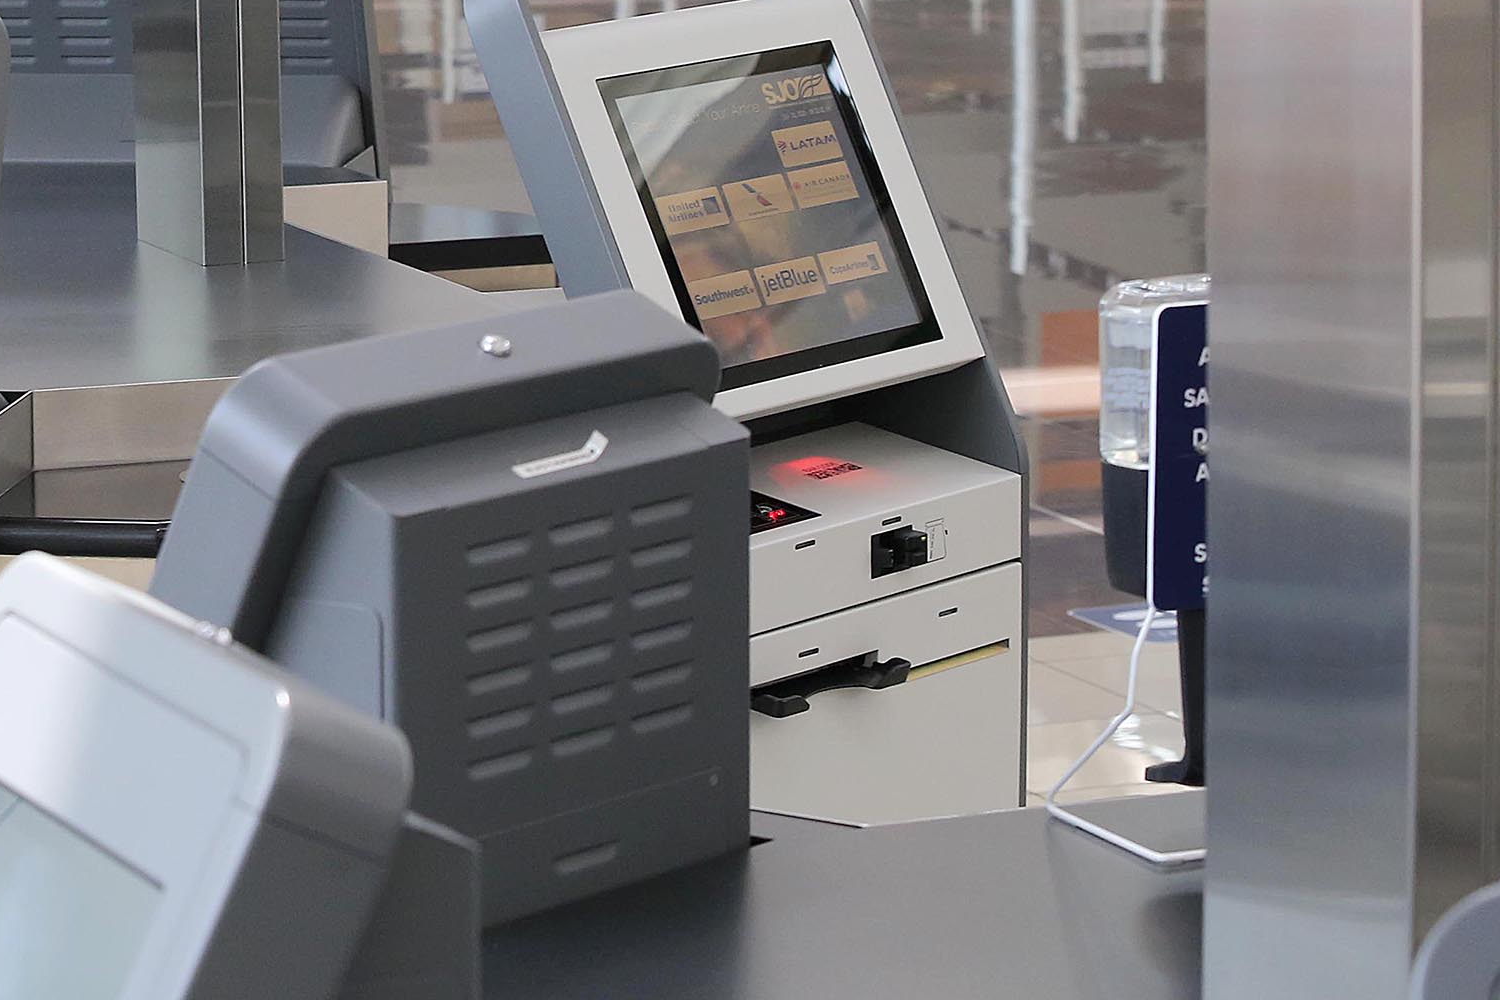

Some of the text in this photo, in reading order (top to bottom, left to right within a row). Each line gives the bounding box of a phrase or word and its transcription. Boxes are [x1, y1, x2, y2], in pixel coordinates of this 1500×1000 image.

[789, 133, 836, 150] LATAM
[761, 268, 818, 297] jetBlue
[694, 286, 750, 305] Southwest
